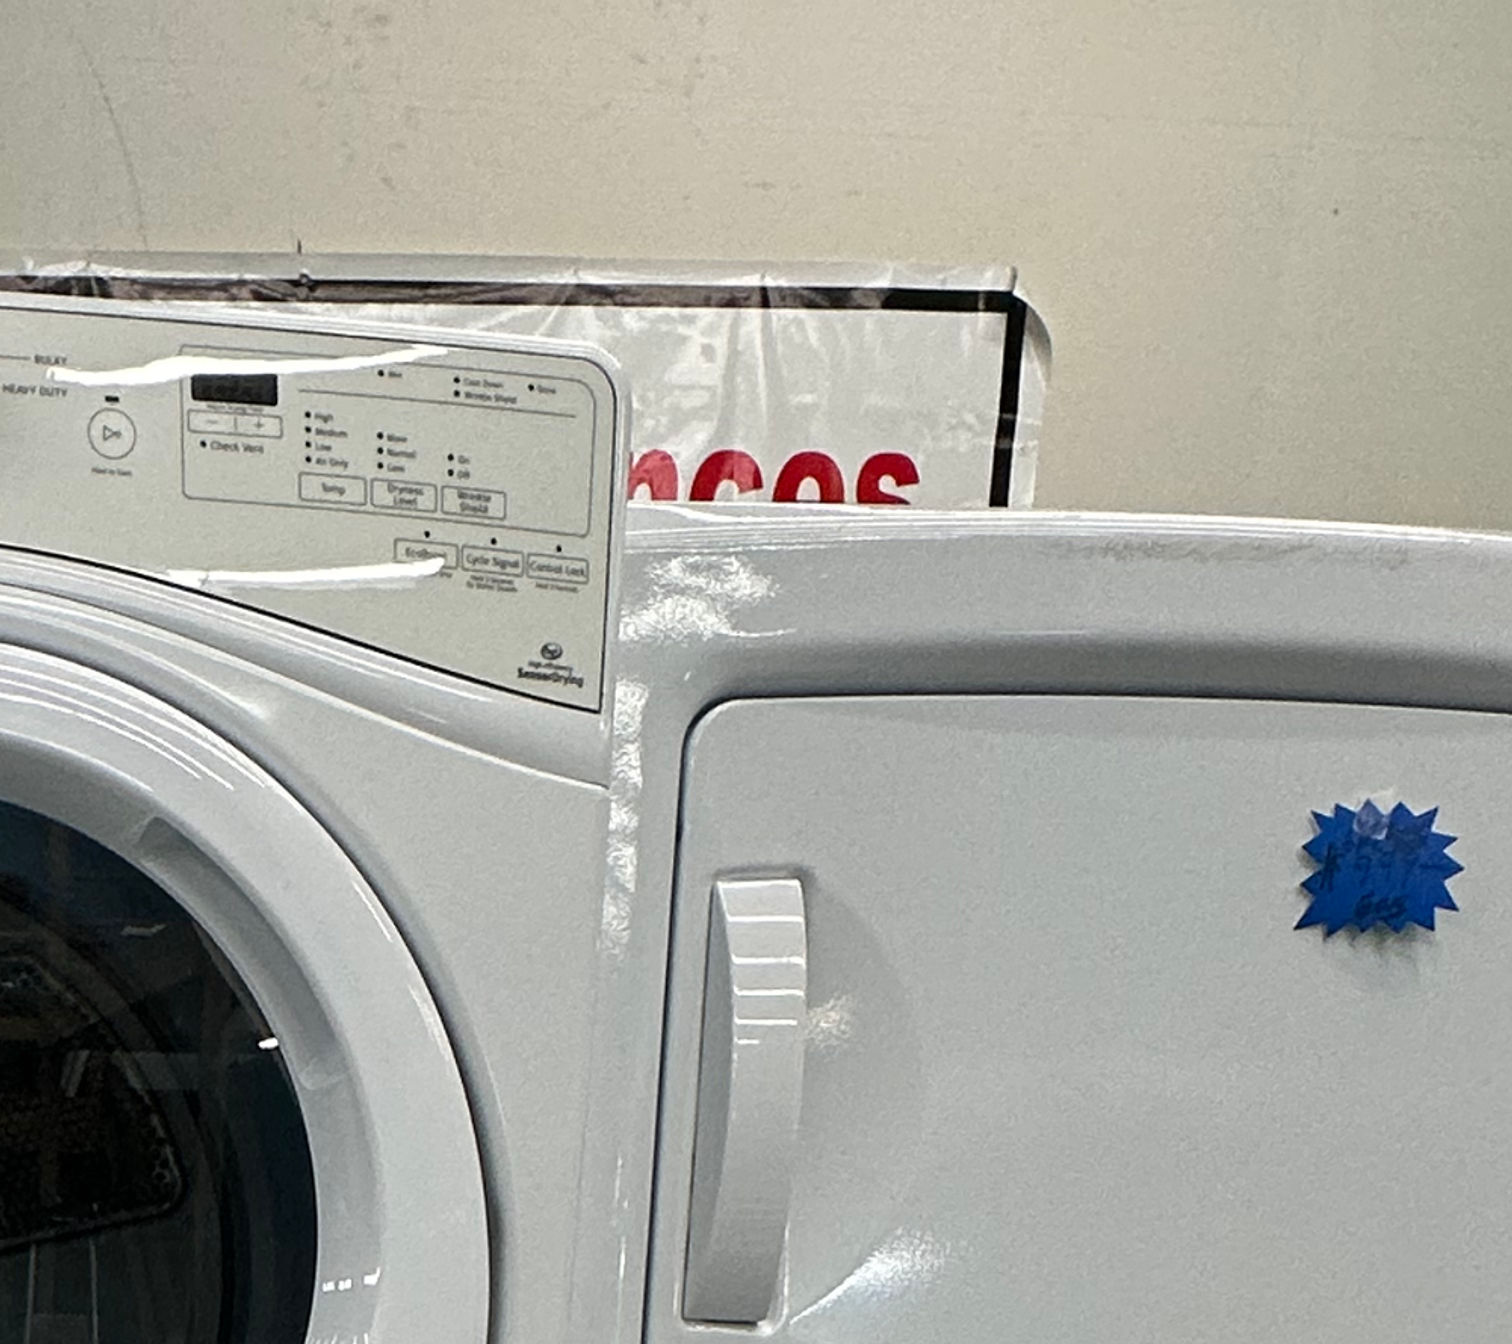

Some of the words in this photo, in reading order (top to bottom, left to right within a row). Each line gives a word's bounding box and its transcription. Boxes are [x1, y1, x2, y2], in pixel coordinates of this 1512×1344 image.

[39, 386, 68, 398] DUTY
[314, 413, 333, 424] High
[315, 427, 348, 438] Medium
[209, 440, 239, 452] Check
[315, 442, 333, 451] Low
[329, 457, 350, 470] Only
[388, 482, 424, 496] Dryness
[459, 502, 489, 514] Shield
[466, 553, 489, 566] Cycle
[491, 556, 520, 571] Signal
[529, 559, 563, 574] Control
[564, 563, 585, 577] Lock
